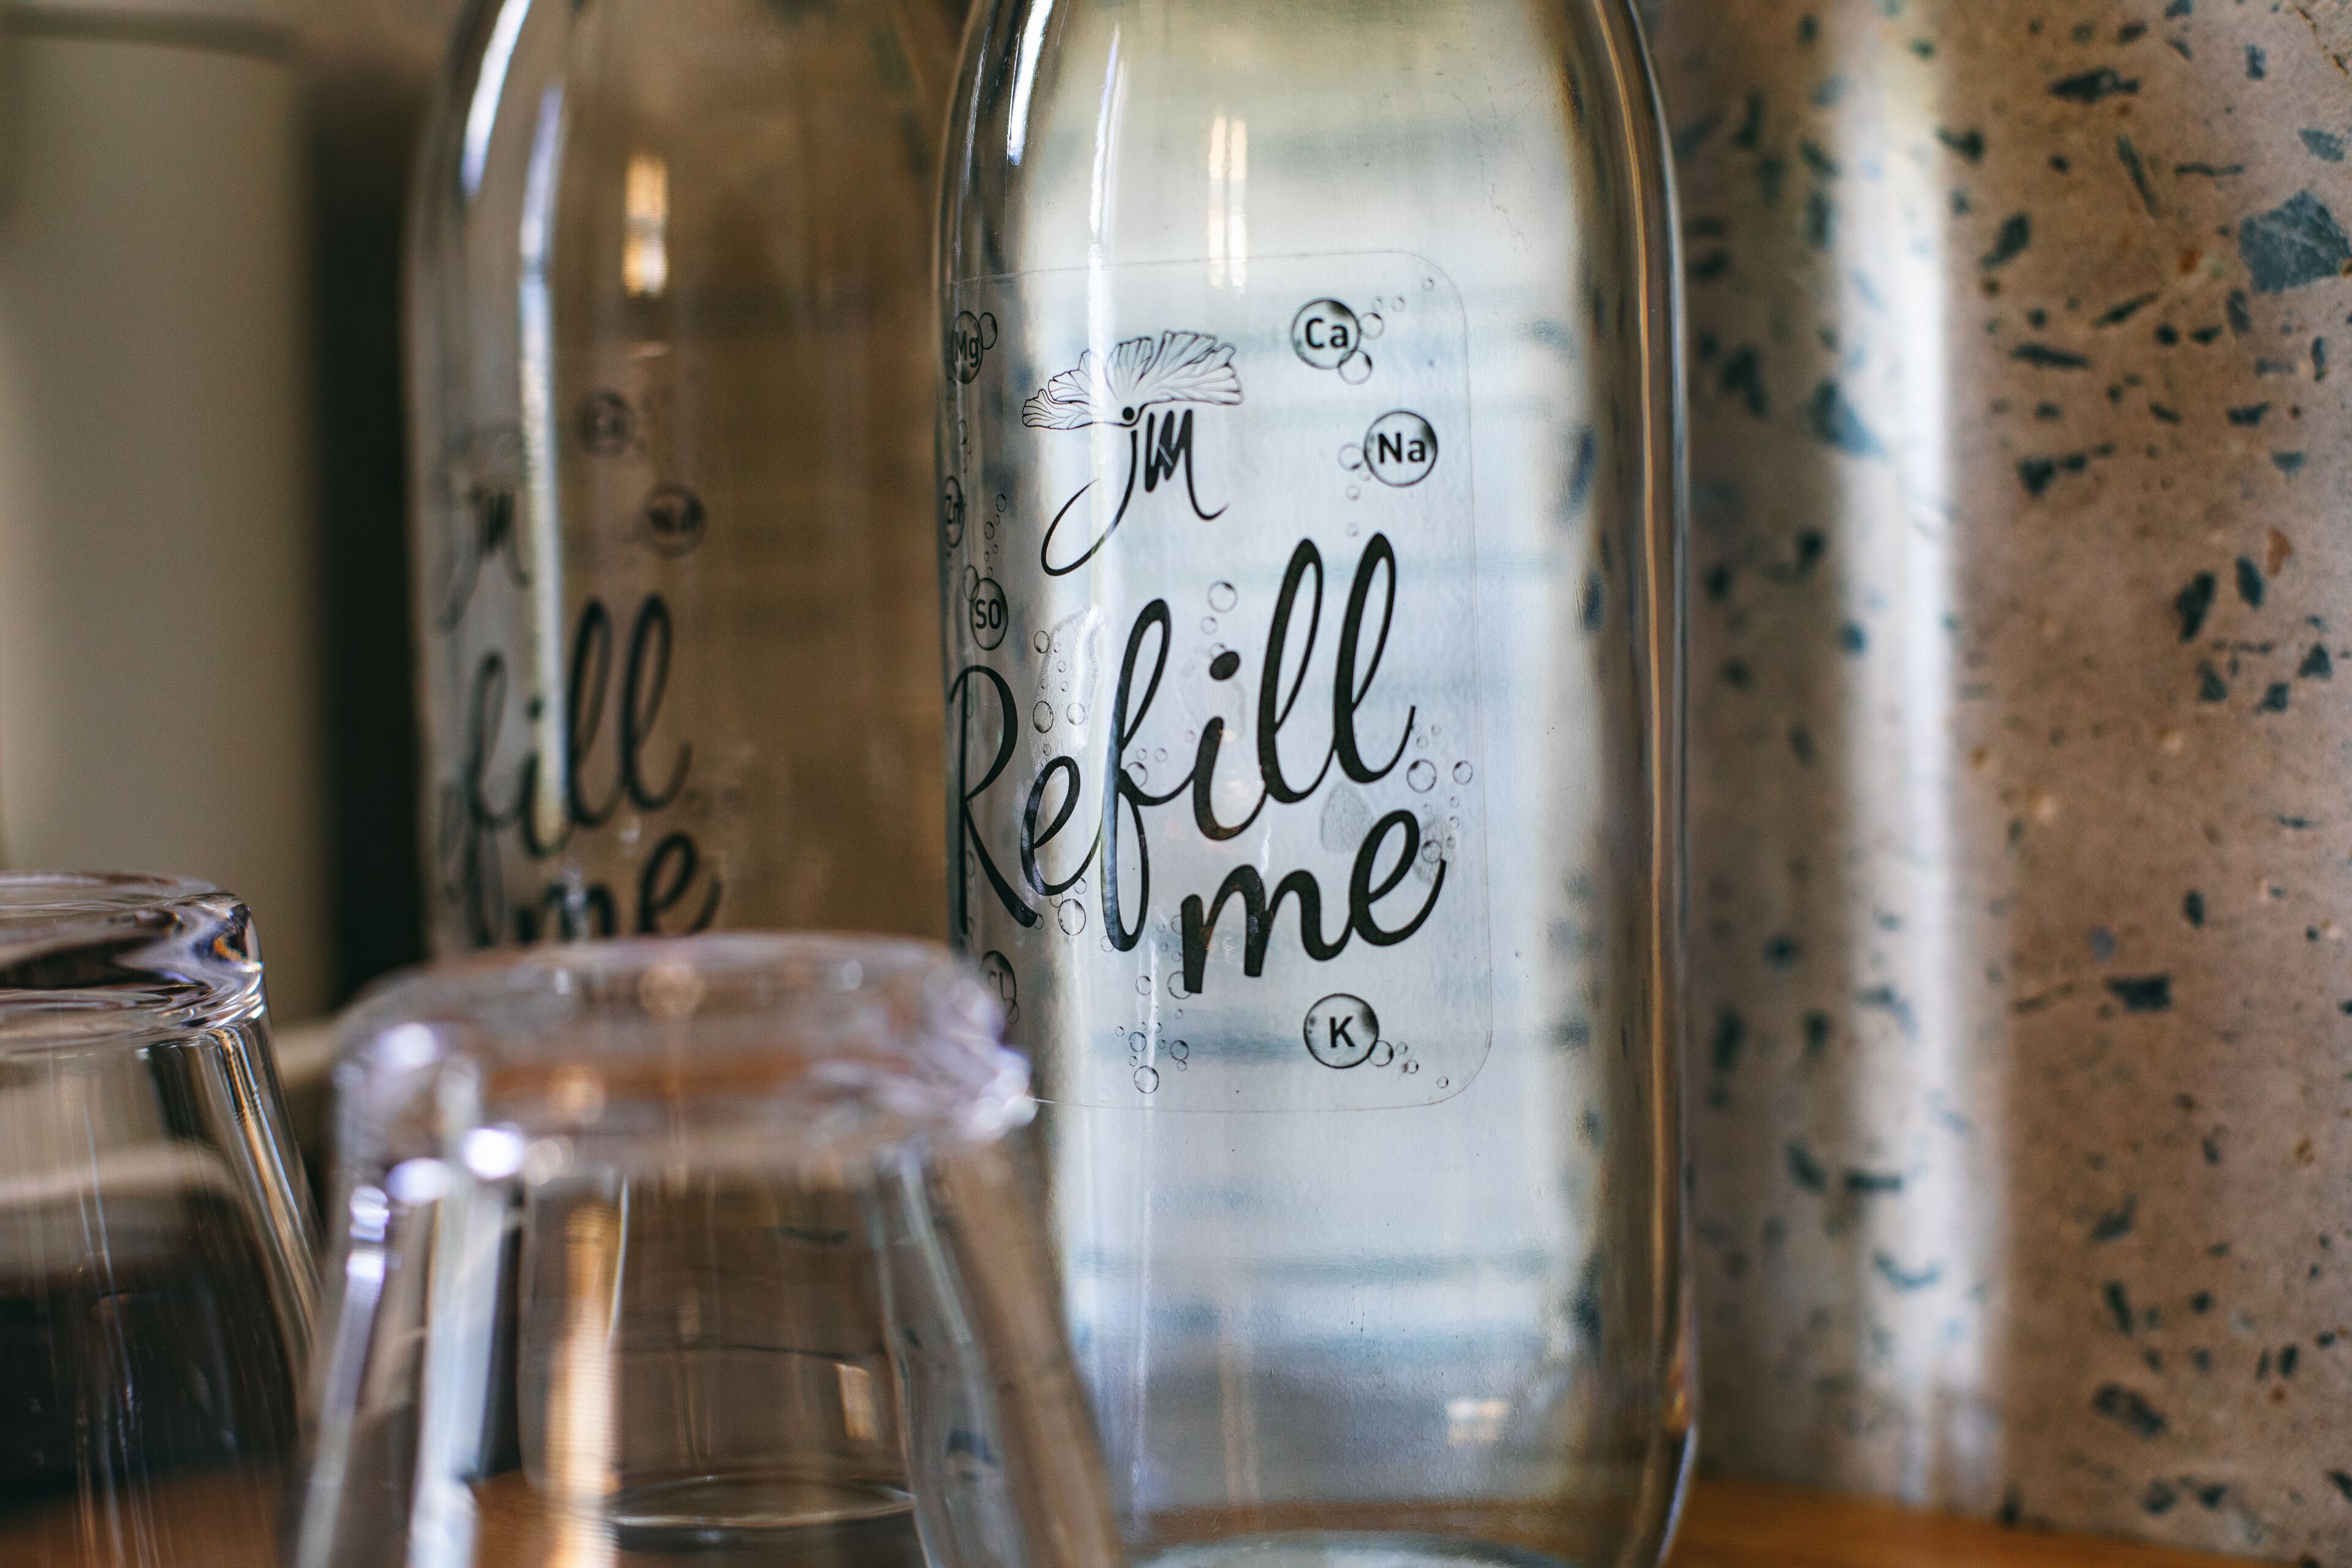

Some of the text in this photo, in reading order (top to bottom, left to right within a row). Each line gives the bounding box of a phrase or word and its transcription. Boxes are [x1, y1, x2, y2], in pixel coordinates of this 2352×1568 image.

[955, 330, 979, 368] Mg
[1305, 317, 1349, 350] Ca
[1378, 431, 1426, 464] Na
[949, 532, 1416, 952] Refill
[1180, 809, 1447, 995] me
[1329, 1016, 1356, 1048] K
